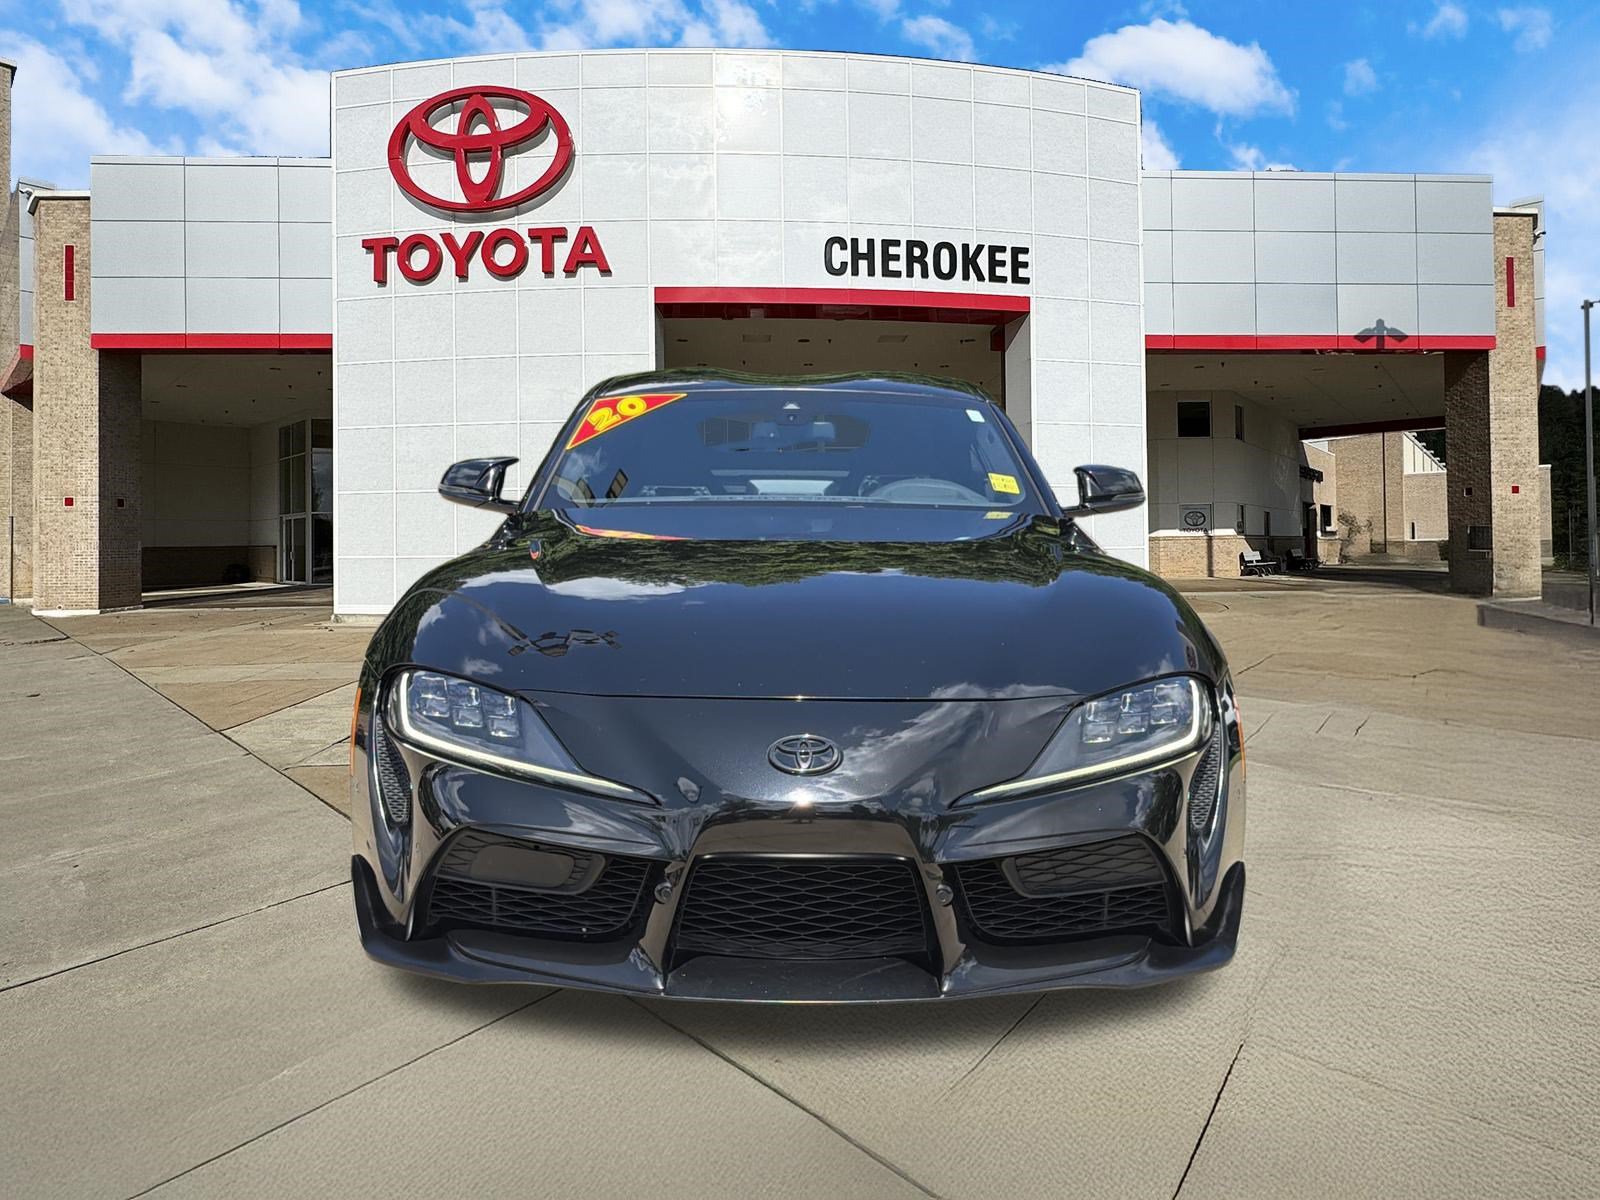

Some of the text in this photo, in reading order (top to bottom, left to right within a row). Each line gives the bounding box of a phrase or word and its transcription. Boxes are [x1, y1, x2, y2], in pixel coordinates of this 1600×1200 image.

[362, 226, 612, 286] TOYOTA
[824, 236, 1031, 284] CHEROKEE
[586, 396, 648, 432] 20
